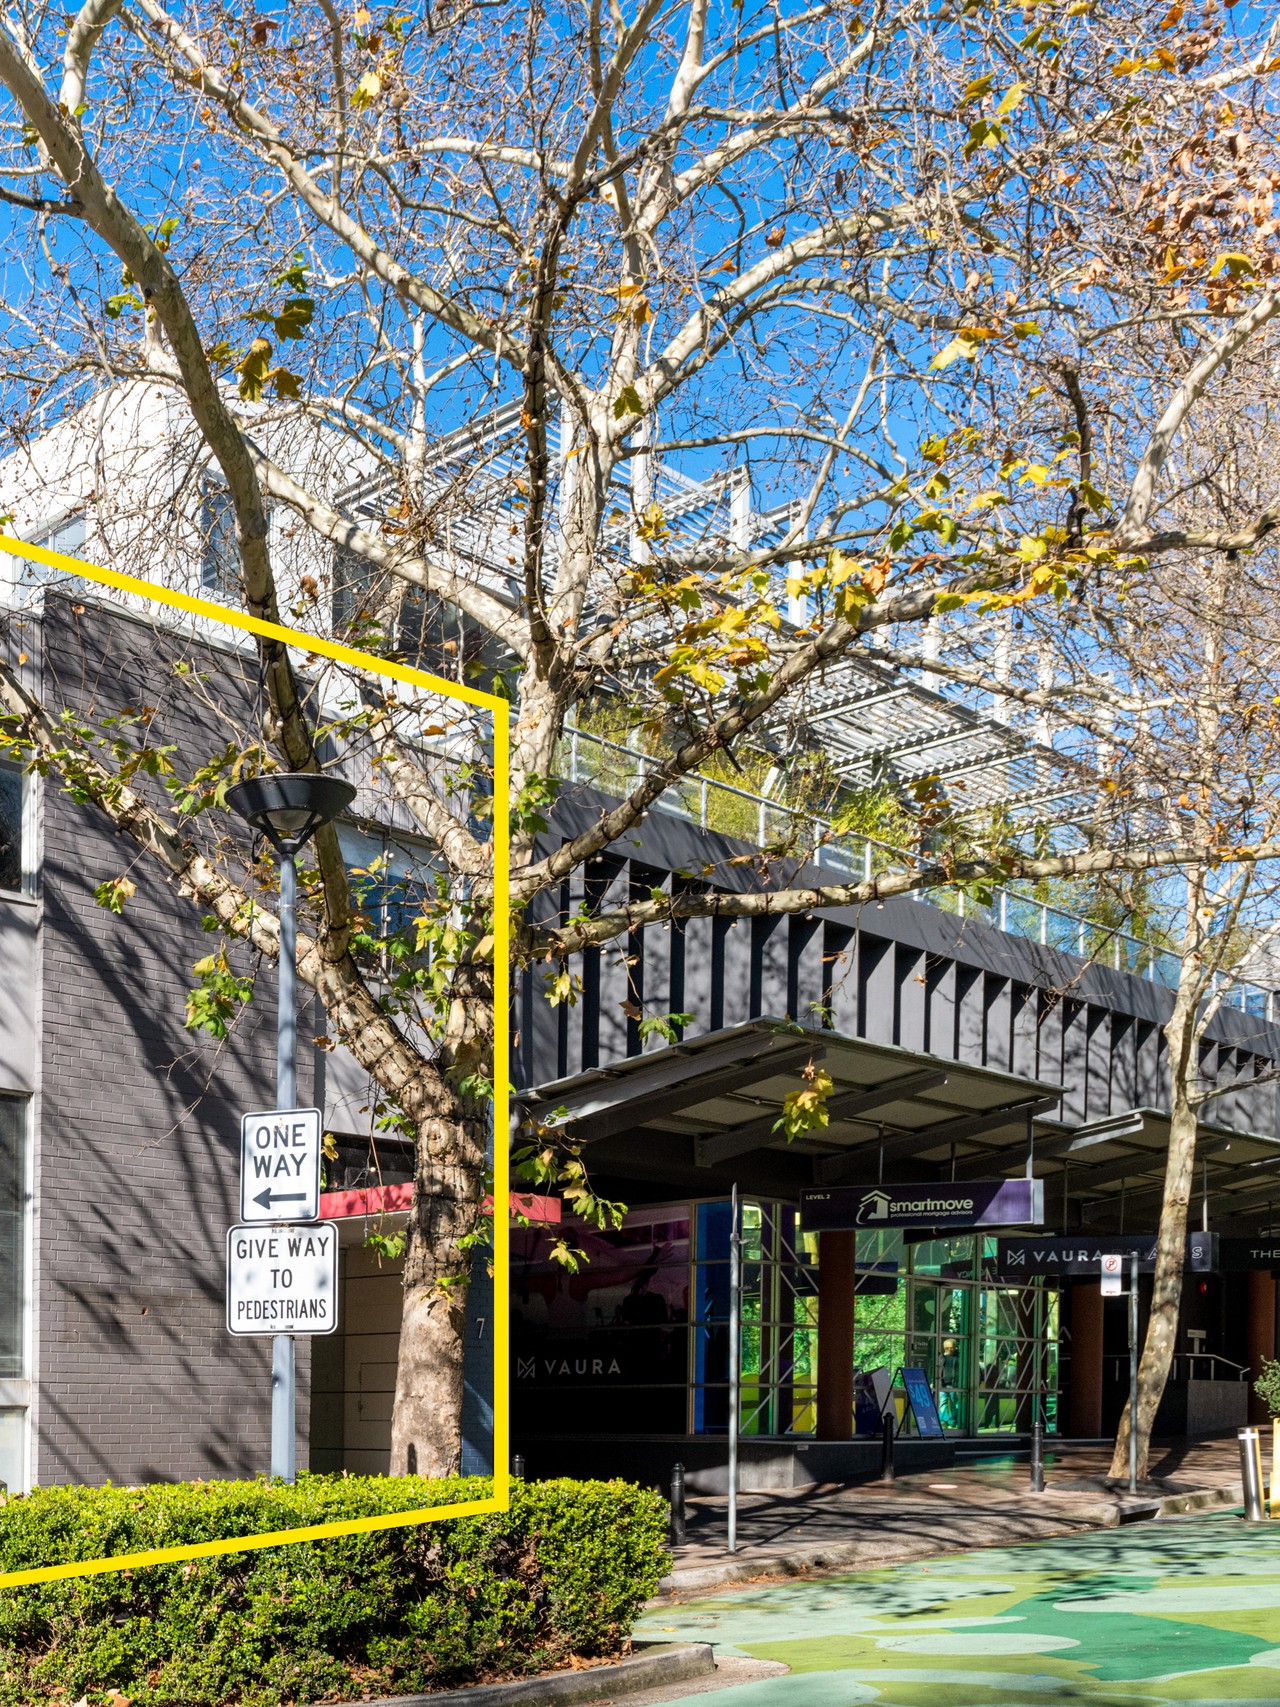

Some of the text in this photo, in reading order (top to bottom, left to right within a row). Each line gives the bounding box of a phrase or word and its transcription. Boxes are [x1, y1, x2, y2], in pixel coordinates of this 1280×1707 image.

[255, 1123, 306, 1149] ONE
[253, 1152, 307, 1178] WAY
[890, 1198, 974, 1212] smartmove
[237, 1237, 329, 1259] GIVE WAY
[1033, 1249, 1102, 1262] VAURA
[1249, 1249, 1280, 1259] THE
[270, 1269, 293, 1288] TO
[238, 1299, 327, 1320] PEDESTRIANS
[476, 1317, 485, 1339] 7
[544, 1358, 621, 1375] VAURA
[909, 1383, 931, 1408] $49
